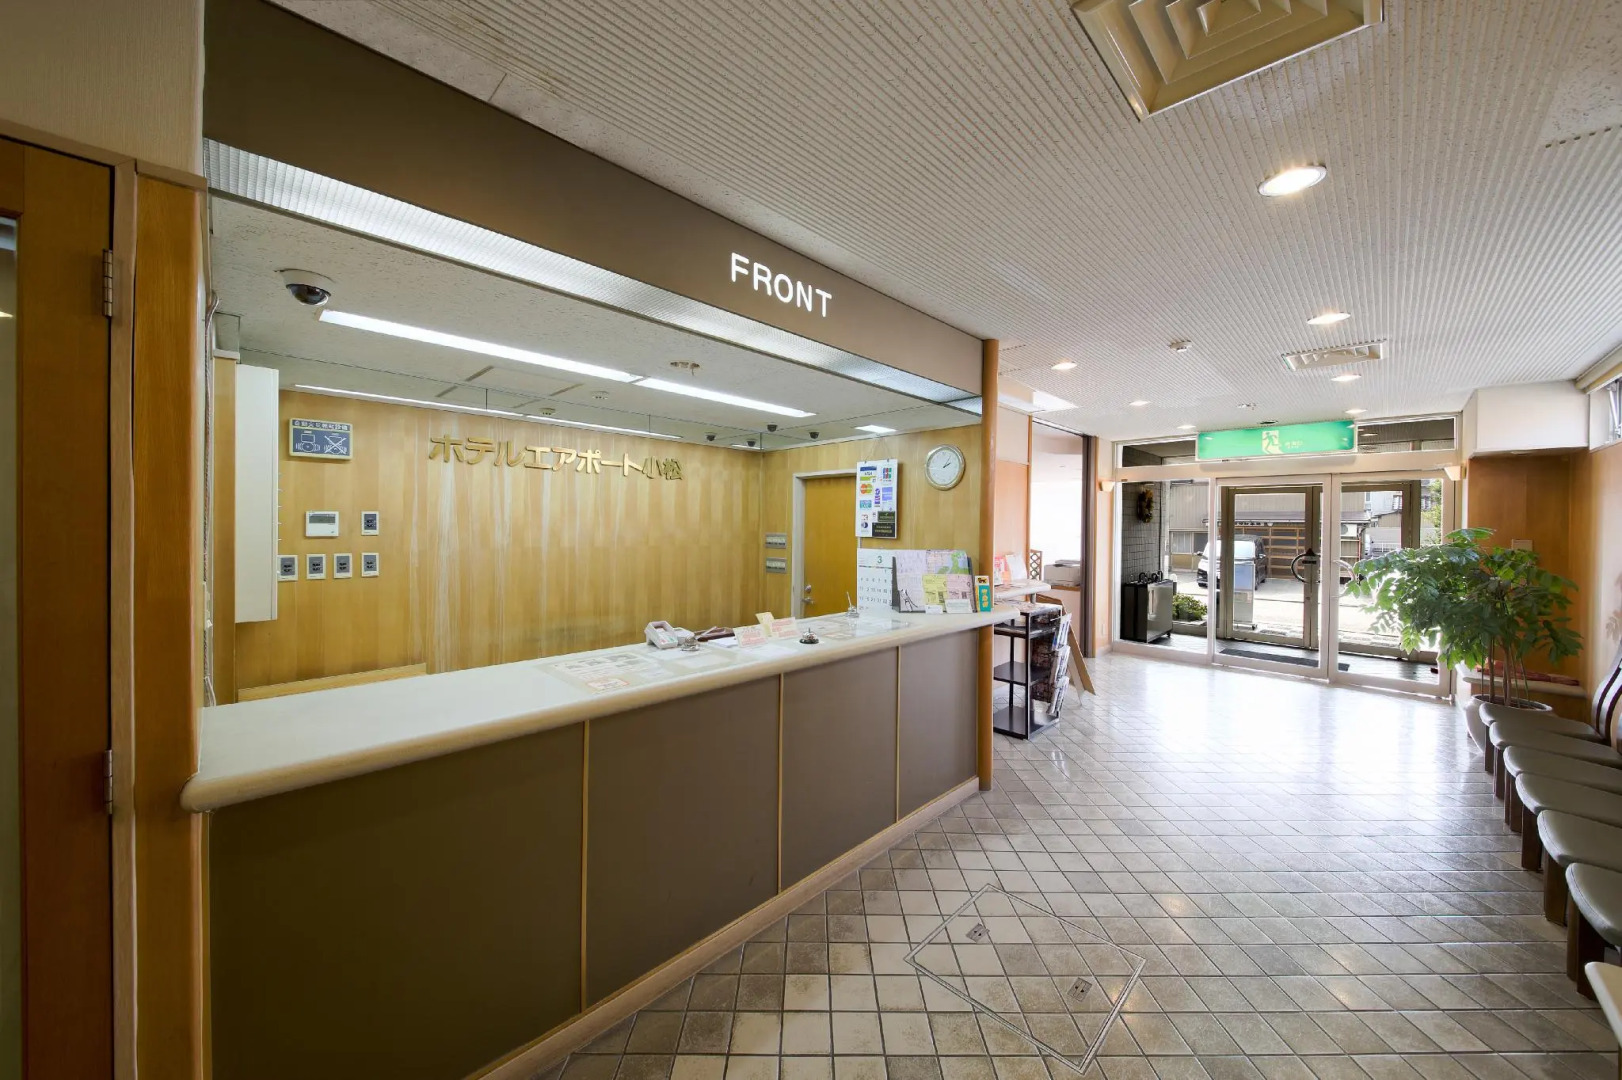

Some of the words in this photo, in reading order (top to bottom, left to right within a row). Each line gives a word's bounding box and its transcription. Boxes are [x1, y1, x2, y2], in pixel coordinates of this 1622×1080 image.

[731, 252, 833, 318] FRONT
[429, 434, 684, 481] ホテルエアポート小松
